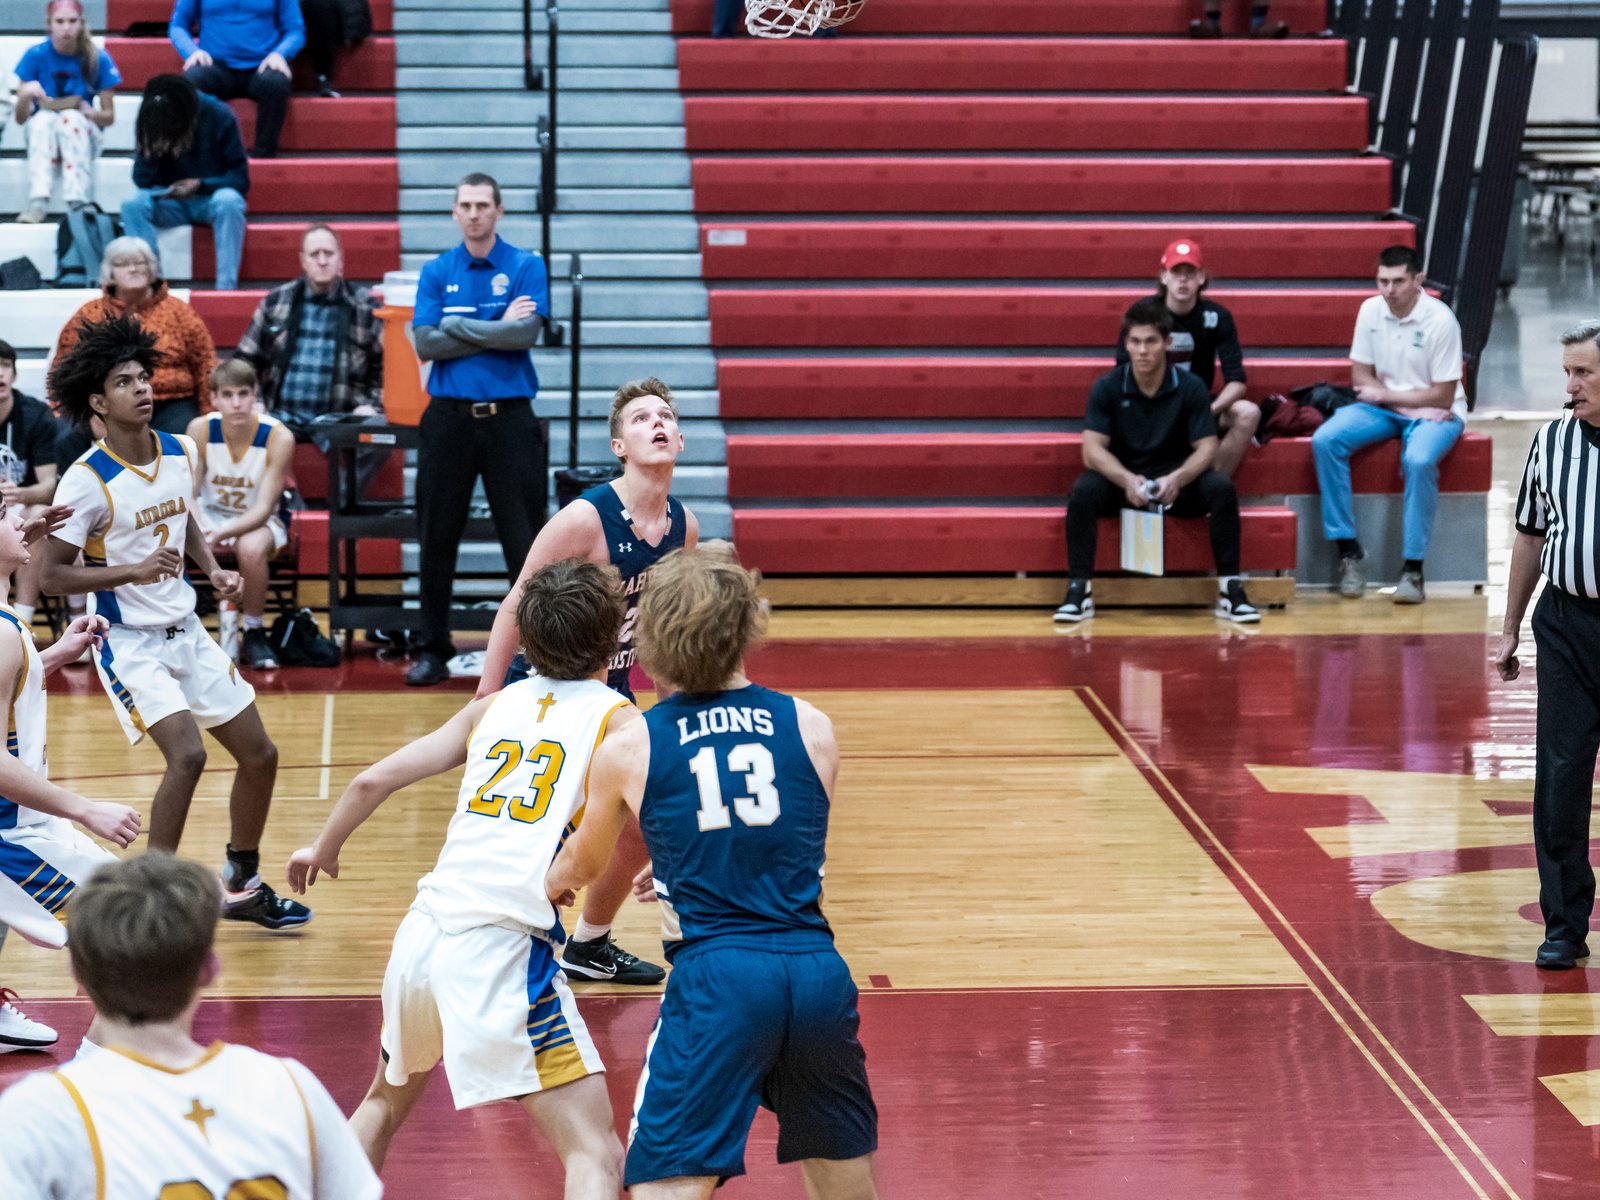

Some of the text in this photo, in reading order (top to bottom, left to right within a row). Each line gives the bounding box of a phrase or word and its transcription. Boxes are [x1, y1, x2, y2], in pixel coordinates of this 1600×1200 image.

[135, 496, 187, 530] AURORA
[676, 706, 774, 746] LIONS
[466, 739, 566, 824] 23
[689, 742, 781, 832] 13
